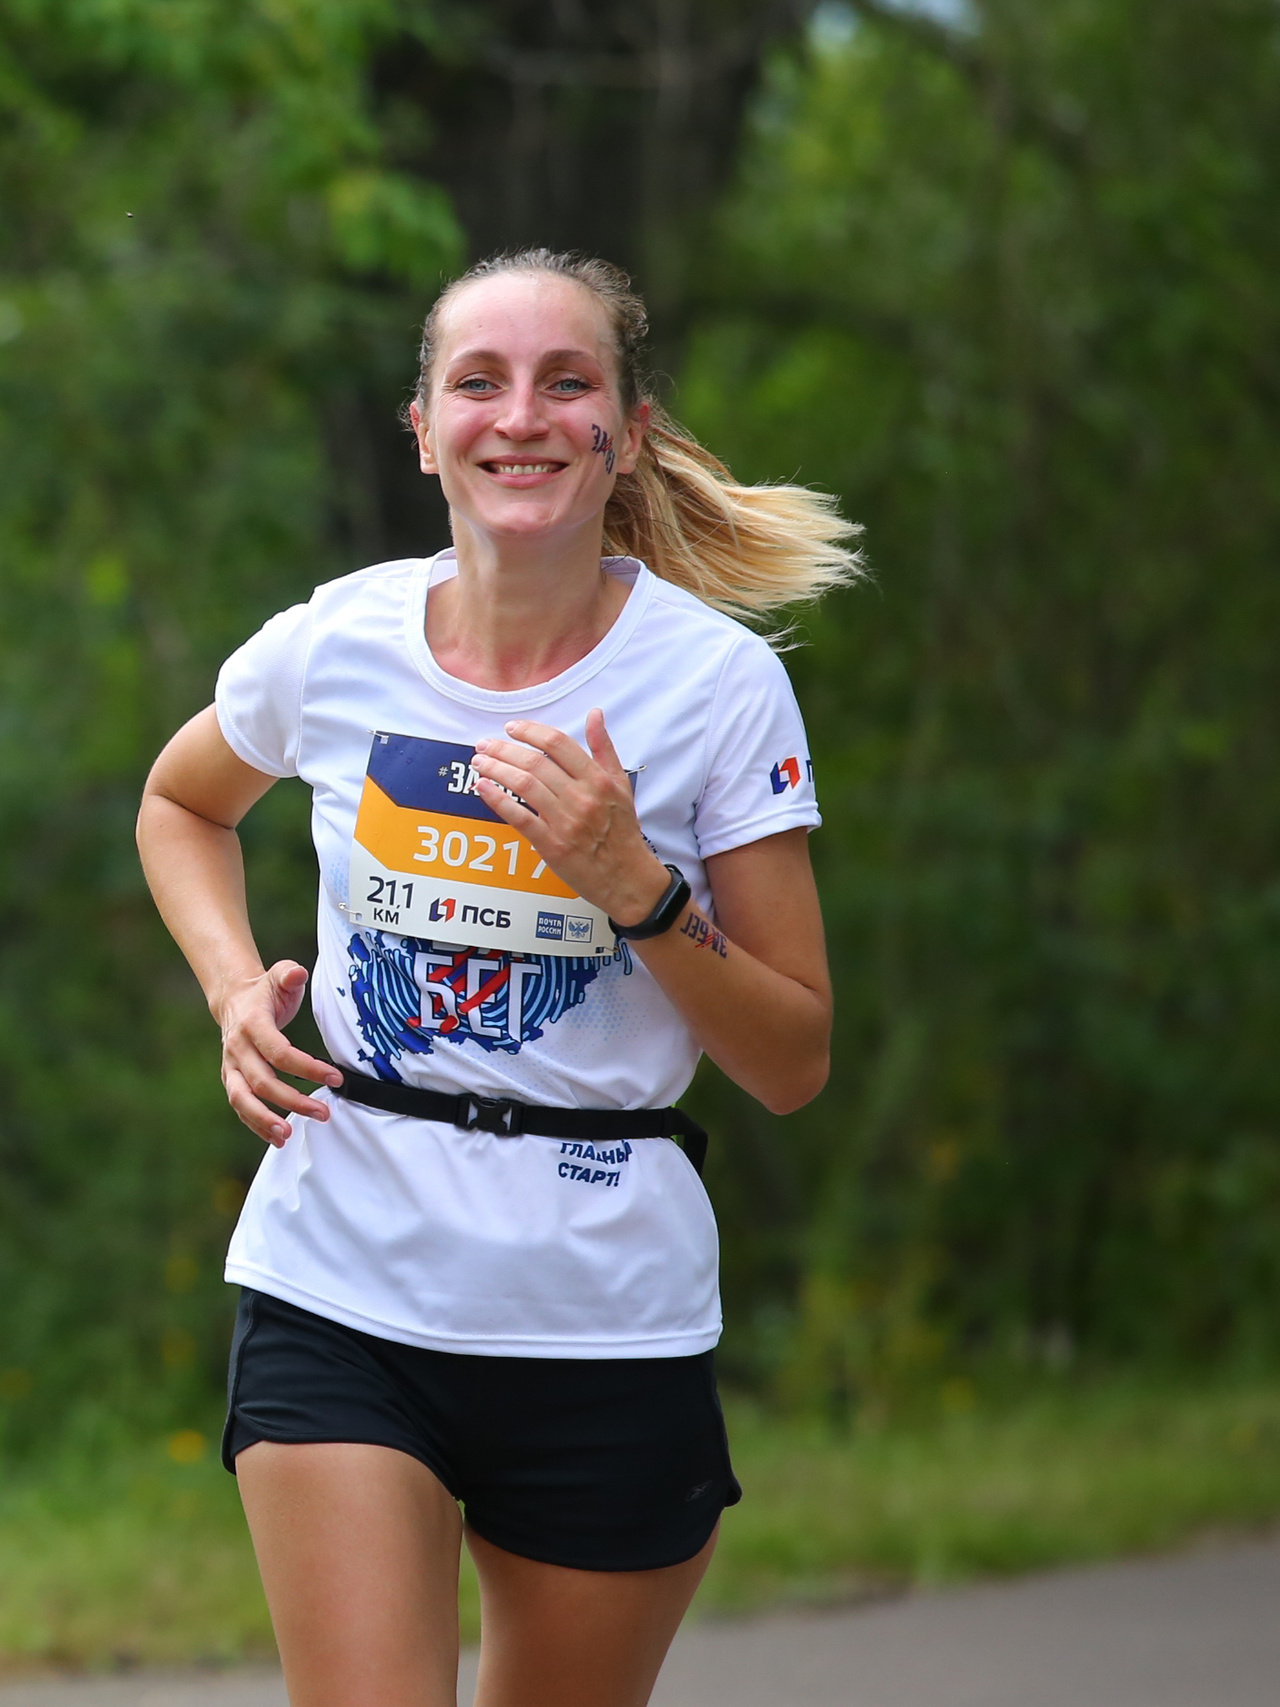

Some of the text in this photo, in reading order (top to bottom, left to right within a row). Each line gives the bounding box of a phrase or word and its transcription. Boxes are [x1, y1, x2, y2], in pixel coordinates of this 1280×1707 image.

[366, 875, 414, 909] 21,1
[373, 907, 400, 926] КМ
[461, 904, 512, 929] ПСБ
[538, 917, 562, 928] ПОЧТА
[537, 925, 562, 936] РОССИИ
[558, 1162, 621, 1188] СТАРТ!
